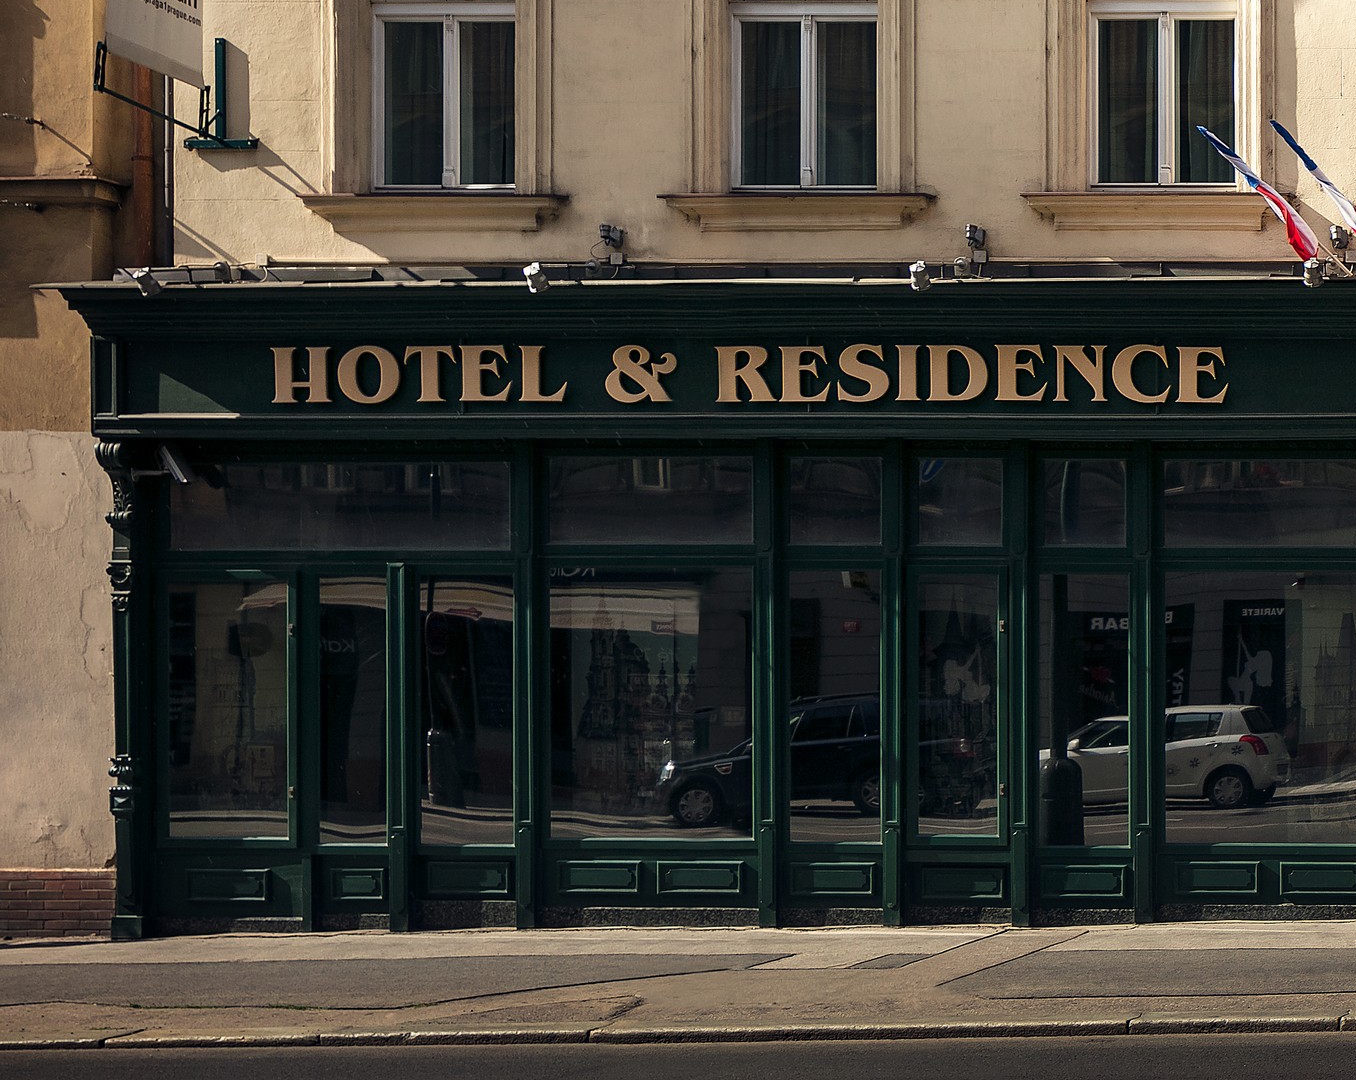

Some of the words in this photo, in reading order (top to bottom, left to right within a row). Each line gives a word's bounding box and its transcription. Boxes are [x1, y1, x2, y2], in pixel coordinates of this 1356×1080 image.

[269, 344, 568, 404] HOTEL
[604, 344, 677, 404] &
[714, 343, 1229, 404] RESIDENCE
